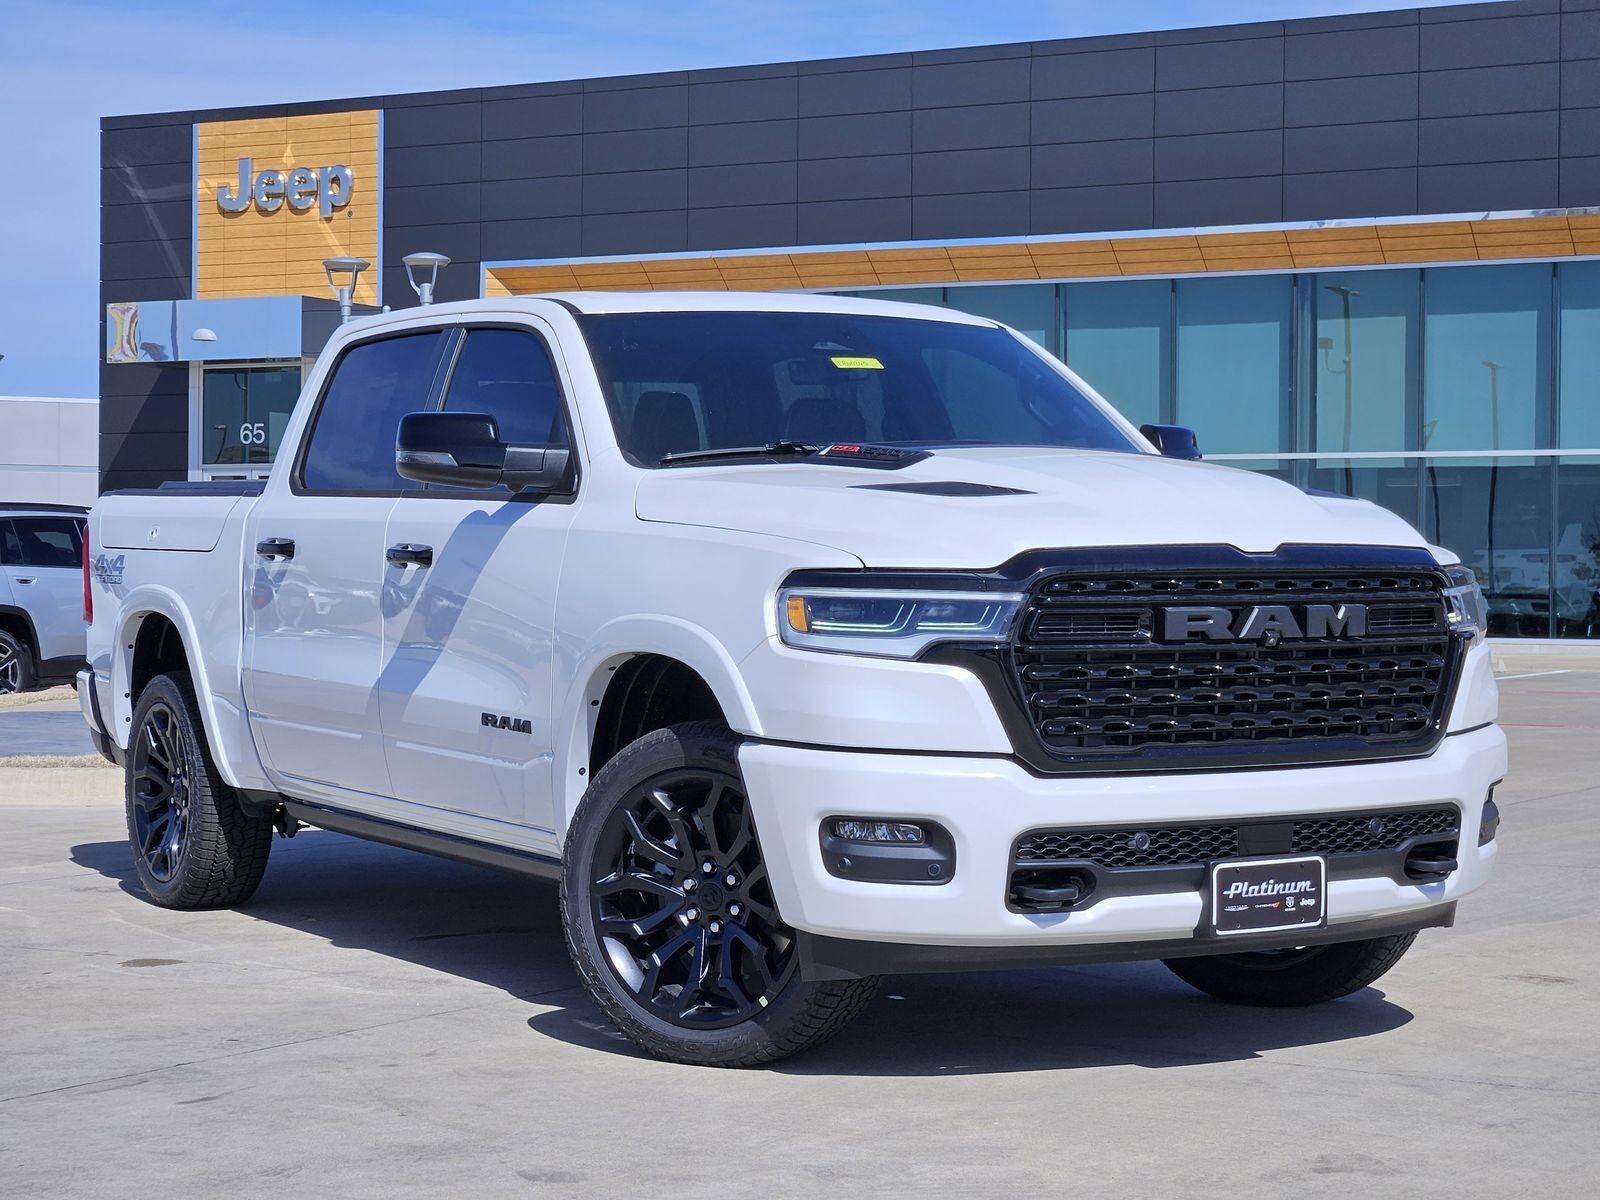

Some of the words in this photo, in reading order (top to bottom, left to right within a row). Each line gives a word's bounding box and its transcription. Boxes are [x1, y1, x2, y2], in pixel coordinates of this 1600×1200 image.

[216, 157, 352, 217] Jeep
[239, 423, 265, 444] 65
[94, 554, 125, 575] 4x4
[1164, 604, 1367, 640] RAM
[481, 712, 532, 734] RAM
[1222, 880, 1316, 898] Platinum
